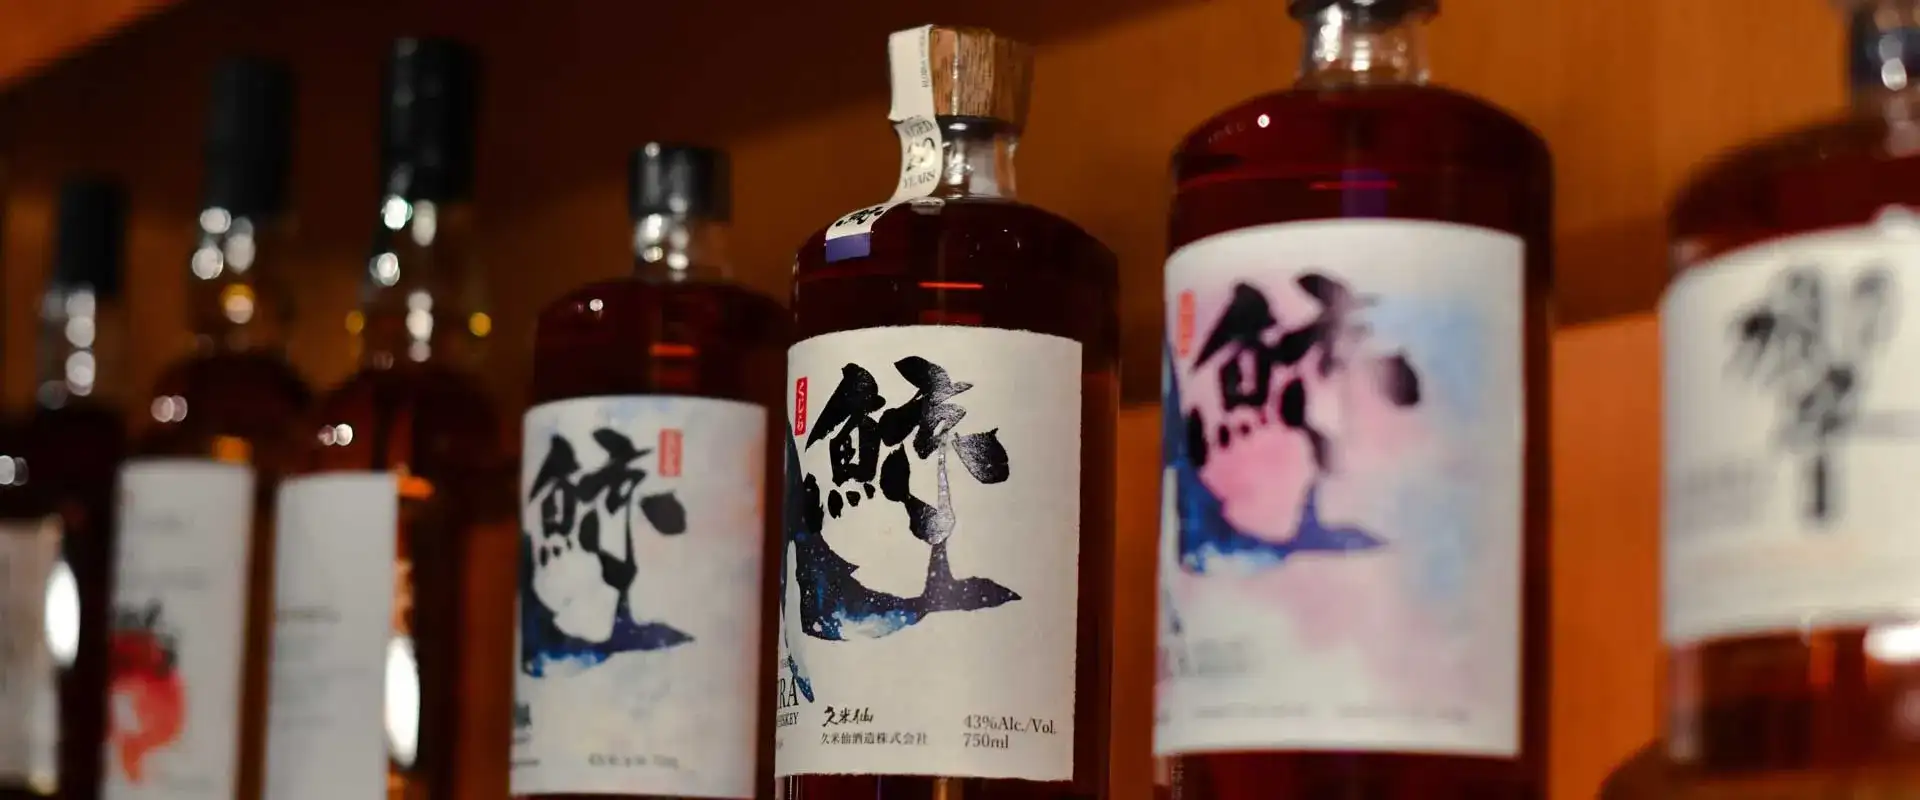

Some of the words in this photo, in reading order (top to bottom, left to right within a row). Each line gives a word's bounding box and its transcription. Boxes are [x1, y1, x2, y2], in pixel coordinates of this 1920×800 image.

[822, 706, 874, 727] 久米仙
[821, 731, 928, 746] 久米仙酒造株式会社
[963, 732, 1009, 749] 750ml
